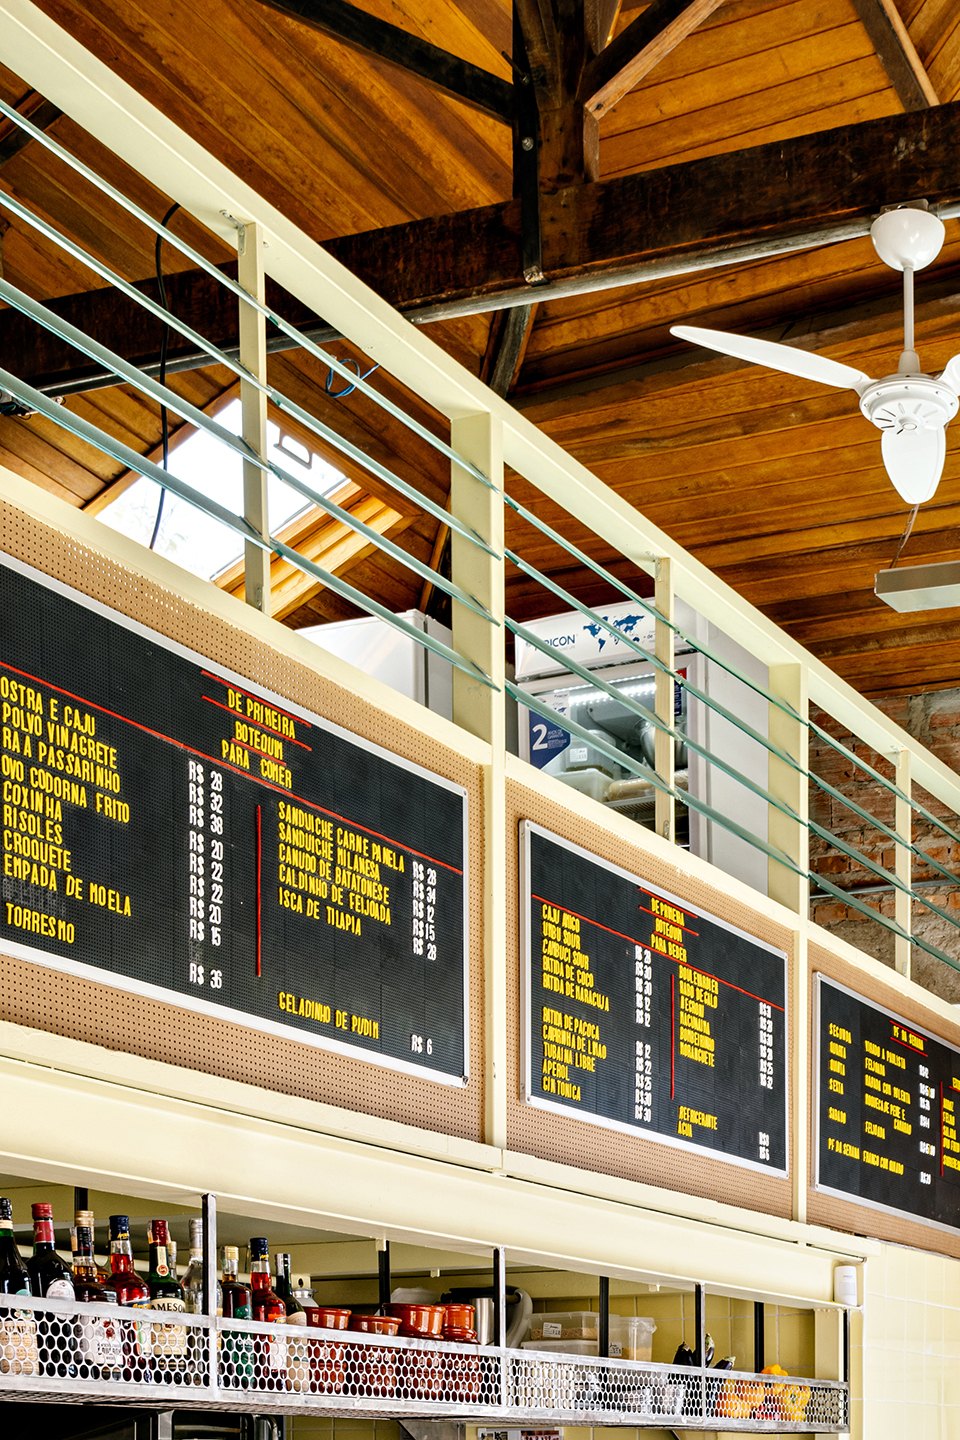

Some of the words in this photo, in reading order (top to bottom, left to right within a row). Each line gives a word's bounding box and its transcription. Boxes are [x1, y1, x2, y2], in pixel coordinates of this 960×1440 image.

[0, 676, 43, 715] OSTRA
[49, 698, 59, 721] E
[64, 706, 96, 737] CAJU
[227, 688, 243, 713] DE
[246, 698, 296, 739] PRIMEIRA
[2, 702, 43, 736] POLVO
[47, 722, 117, 769] VINAGRETE
[235, 721, 283, 760] BOTEQUIM
[532, 723, 548, 750] 2
[2, 726, 21, 753] RA
[23, 734, 32, 758] A
[38, 742, 121, 793] PASSARINHO
[221, 739, 250, 770] PARA
[260, 758, 292, 789] COMER
[1, 754, 25, 782] OVO
[29, 767, 87, 808] CODORNA
[95, 792, 130, 823] FRITO
[188, 760, 204, 784] R$
[210, 770, 223, 792] 28
[3, 780, 62, 822] COXINHA
[189, 782, 204, 806] R$
[210, 792, 223, 814] 32
[3, 804, 63, 845] RISOLES
[189, 804, 204, 828] R$
[210, 813, 223, 835] 38
[3, 829, 71, 872] CROQUETE
[189, 830, 204, 854] R$
[211, 839, 224, 861] 20
[278, 801, 334, 841] SANDUICHE
[336, 827, 369, 857] CARNE
[371, 843, 405, 873] PANELA
[278, 822, 334, 861] SANDUICHE
[337, 847, 380, 881] MILANESA
[189, 852, 205, 876] R$
[211, 861, 224, 883] 22
[278, 843, 317, 873] CANUDO
[318, 858, 332, 881] DE
[335, 866, 390, 905] BATATONESE
[426, 868, 437, 886] 28
[4, 853, 57, 891] EMPADA
[65, 874, 84, 900] DE
[89, 882, 132, 917] MOELA
[189, 874, 205, 898] R$
[211, 883, 224, 904] 22
[279, 864, 328, 899] CALDINHO
[331, 883, 344, 906] DE
[349, 892, 391, 925] FEIJOADA
[426, 886, 436, 905] 34
[189, 896, 205, 919] R$
[208, 904, 222, 925] 20
[279, 886, 303, 914] ISCA
[306, 898, 320, 920] DE
[326, 906, 362, 936] TILAPIA
[426, 904, 435, 924] 12
[542, 904, 560, 924] CAJU
[651, 898, 660, 914] DE
[6, 903, 75, 943] TORRESMO
[189, 918, 205, 941] R$
[210, 926, 221, 946] 15
[425, 923, 436, 942] 15
[427, 942, 437, 961] 28
[563, 929, 581, 950] SOUR
[651, 934, 667, 953] PARA
[668, 942, 687, 962] BEBER
[189, 962, 205, 985] R$
[210, 969, 223, 989] 36
[543, 955, 564, 977] BATIDA
[565, 964, 575, 981] DE
[576, 969, 594, 988] COCO
[572, 951, 589, 970] SOUR
[543, 972, 564, 994] BATIDA
[565, 981, 575, 998] DE
[279, 992, 331, 1023] GELADINHO
[335, 1009, 348, 1030] DE
[351, 1014, 379, 1039] PUDIM
[564, 1014, 573, 1031] DE
[426, 1038, 433, 1055] 6
[577, 1035, 586, 1052] DE
[543, 1059, 569, 1081] APEROL
[575, 1052, 595, 1072] LIBRE
